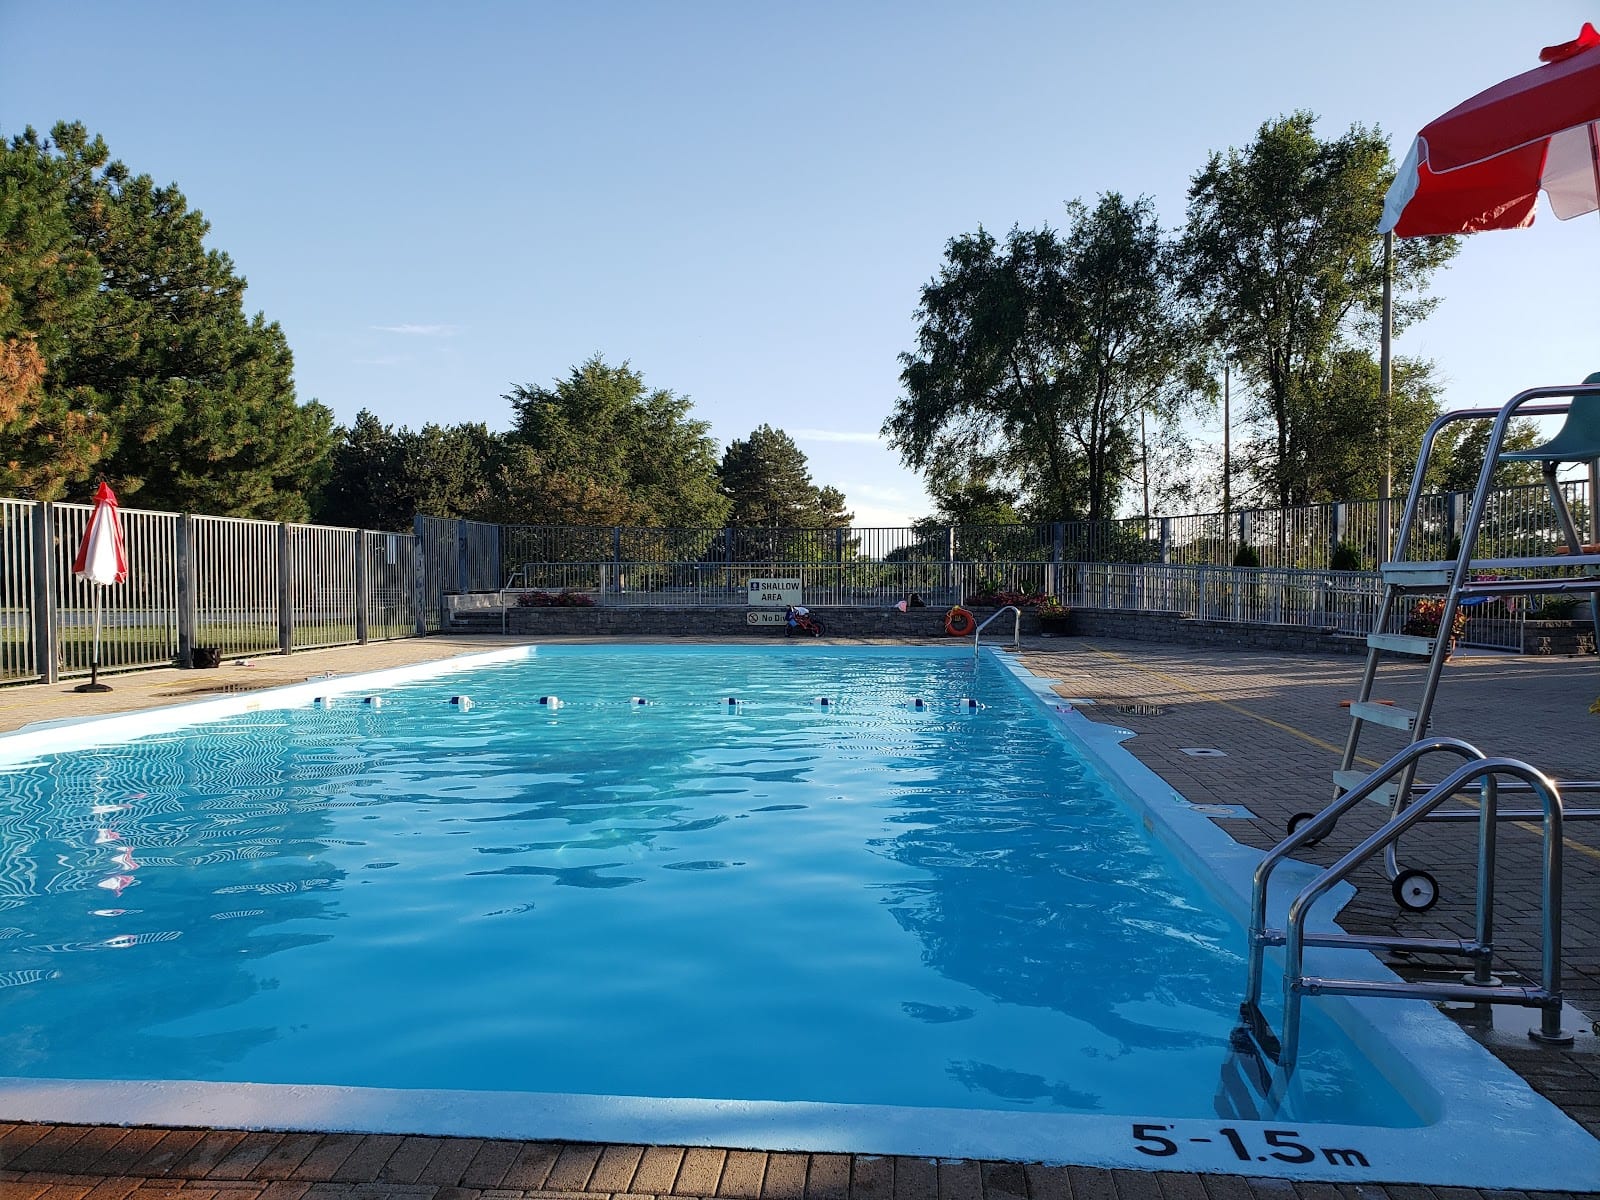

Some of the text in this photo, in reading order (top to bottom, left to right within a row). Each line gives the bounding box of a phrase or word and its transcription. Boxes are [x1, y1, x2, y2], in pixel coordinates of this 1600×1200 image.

[761, 582, 800, 591] SHALLOW
[761, 593, 782, 601] AREA
[762, 614, 773, 622] No
